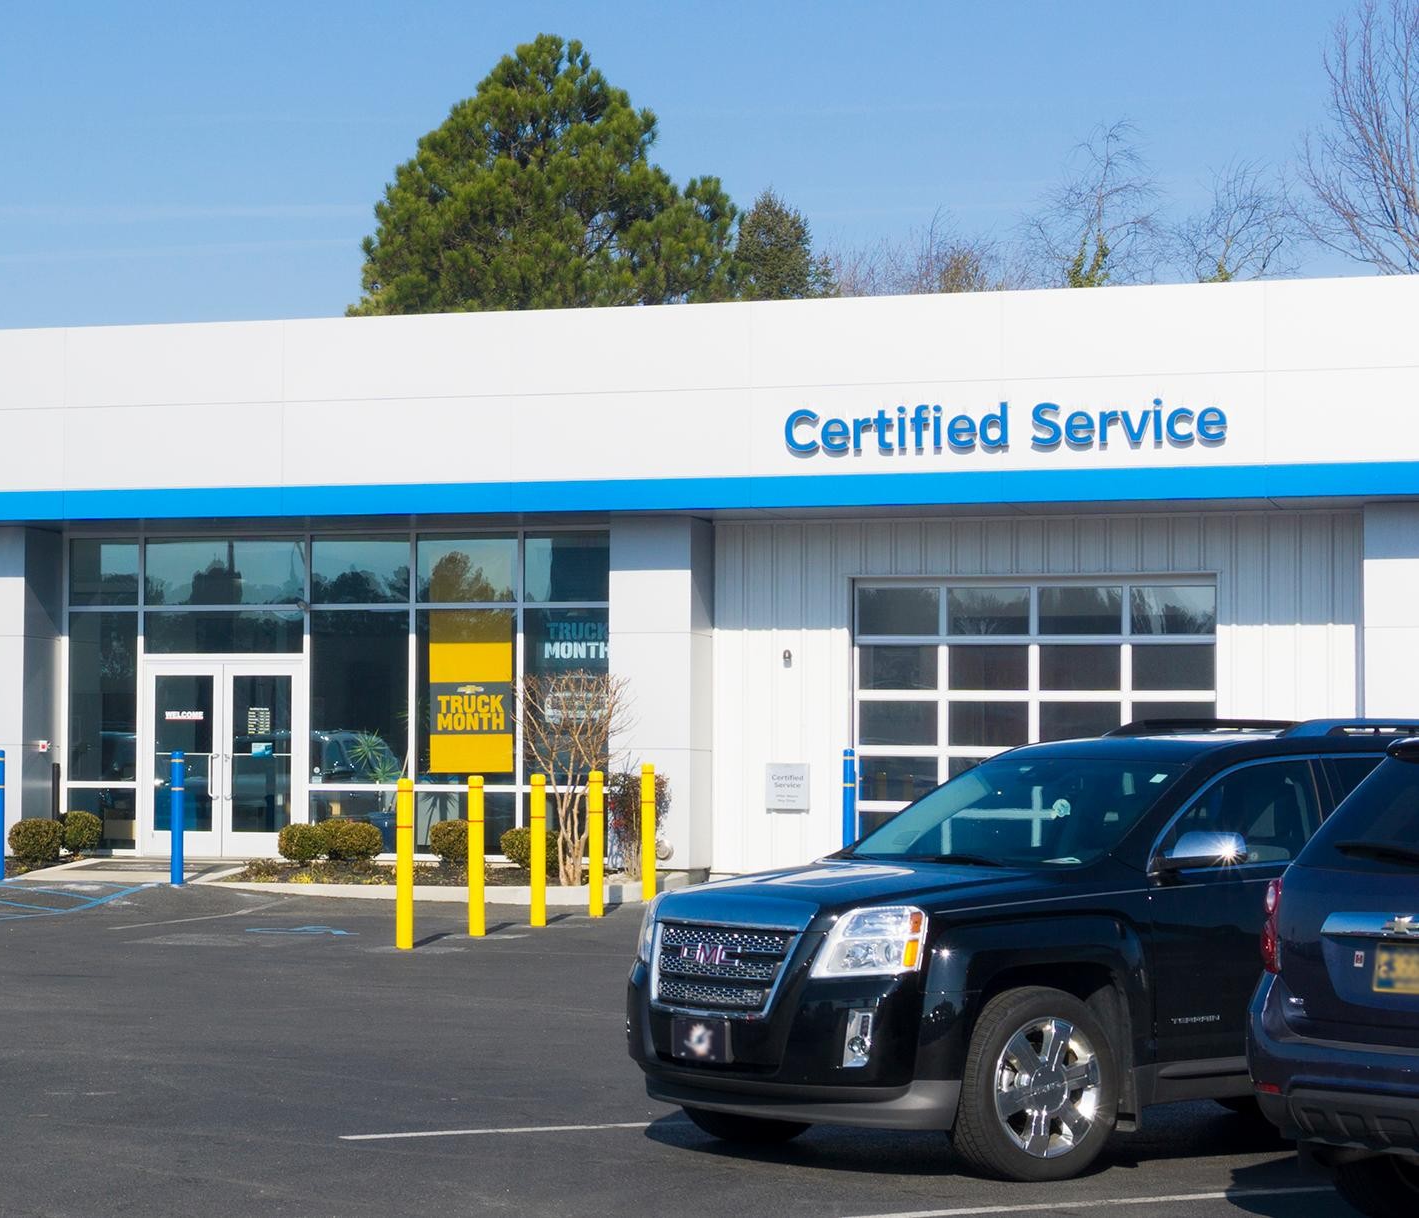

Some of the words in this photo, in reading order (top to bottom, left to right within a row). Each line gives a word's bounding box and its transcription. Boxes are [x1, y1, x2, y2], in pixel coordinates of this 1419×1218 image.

[784, 401, 1009, 457] Certified
[1030, 397, 1227, 452] Service
[547, 622, 609, 640] TRUCK
[544, 641, 609, 659] MONTH
[437, 694, 504, 713] TRUCK
[165, 710, 204, 720] WELCOME
[437, 712, 504, 731] MONTH
[679, 943, 742, 966] GMC
